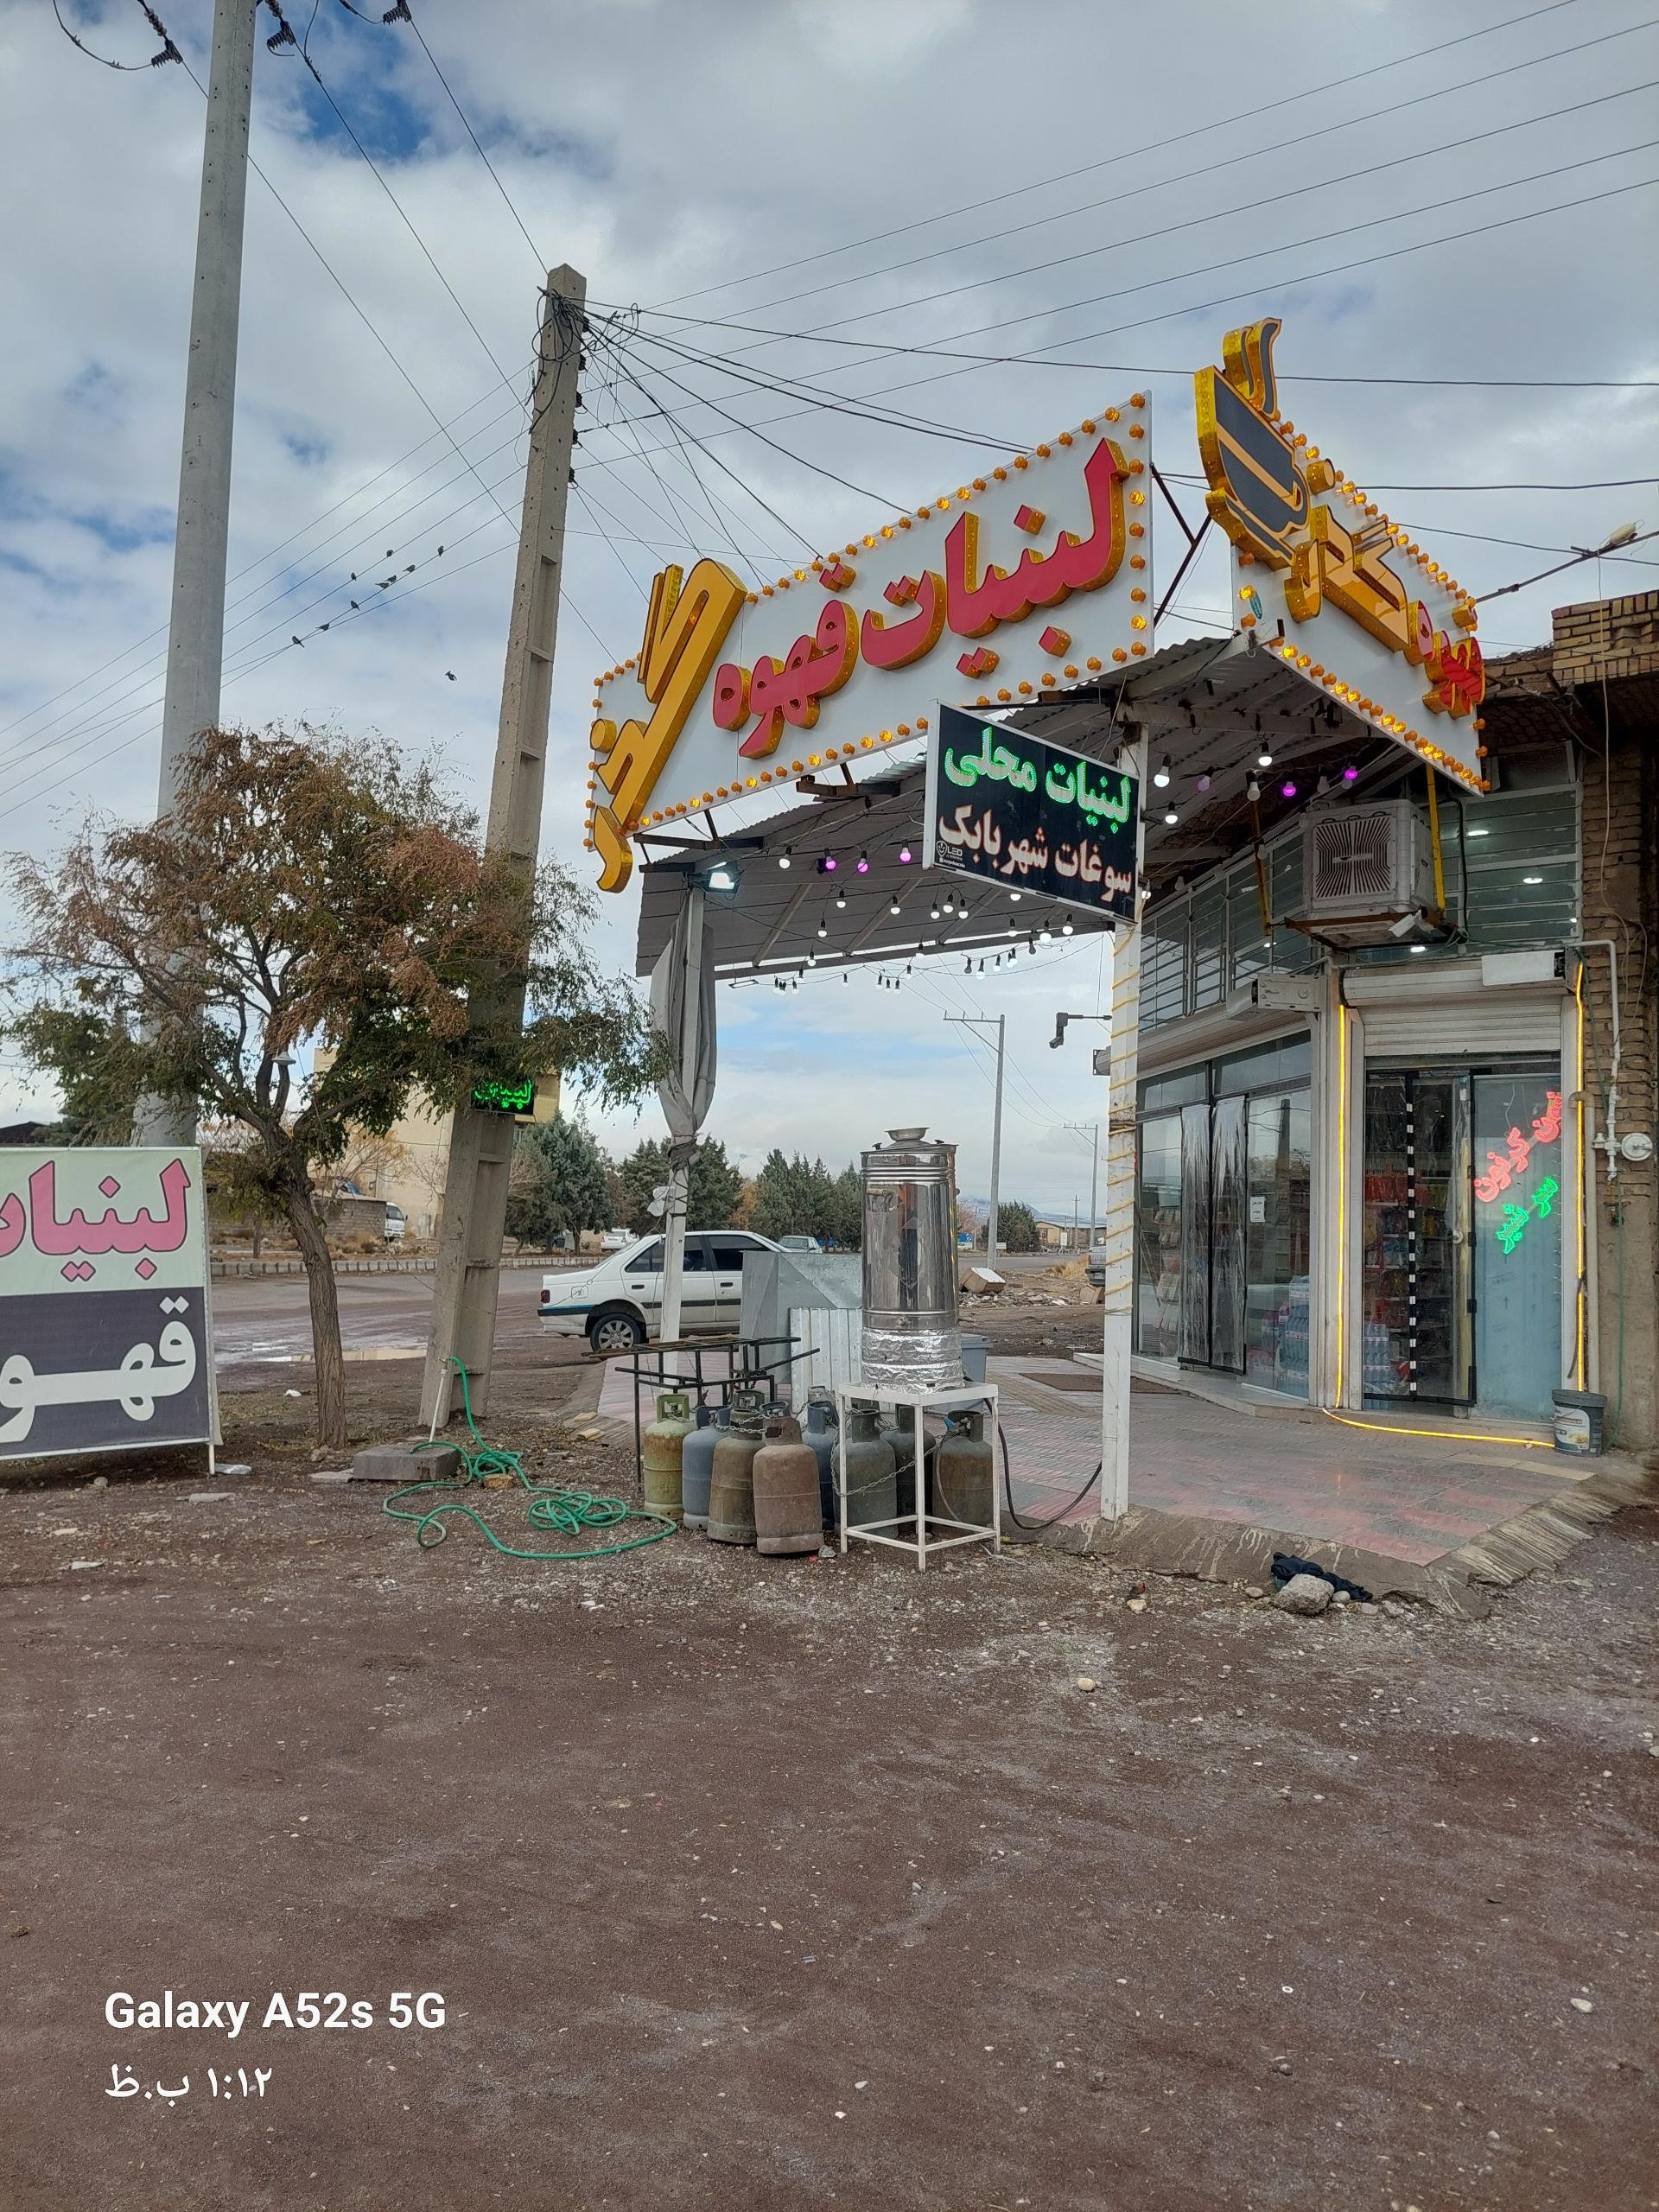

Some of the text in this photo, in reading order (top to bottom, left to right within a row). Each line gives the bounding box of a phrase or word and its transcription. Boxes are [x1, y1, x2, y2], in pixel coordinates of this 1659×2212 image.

[861, 437, 1130, 679] لبنیات
[713, 563, 860, 759] قهوه
[1403, 596, 1485, 719] قهوه
[944, 726, 1131, 834] لبنیات محلی
[939, 804, 1132, 903] سوغات شهر بابک
